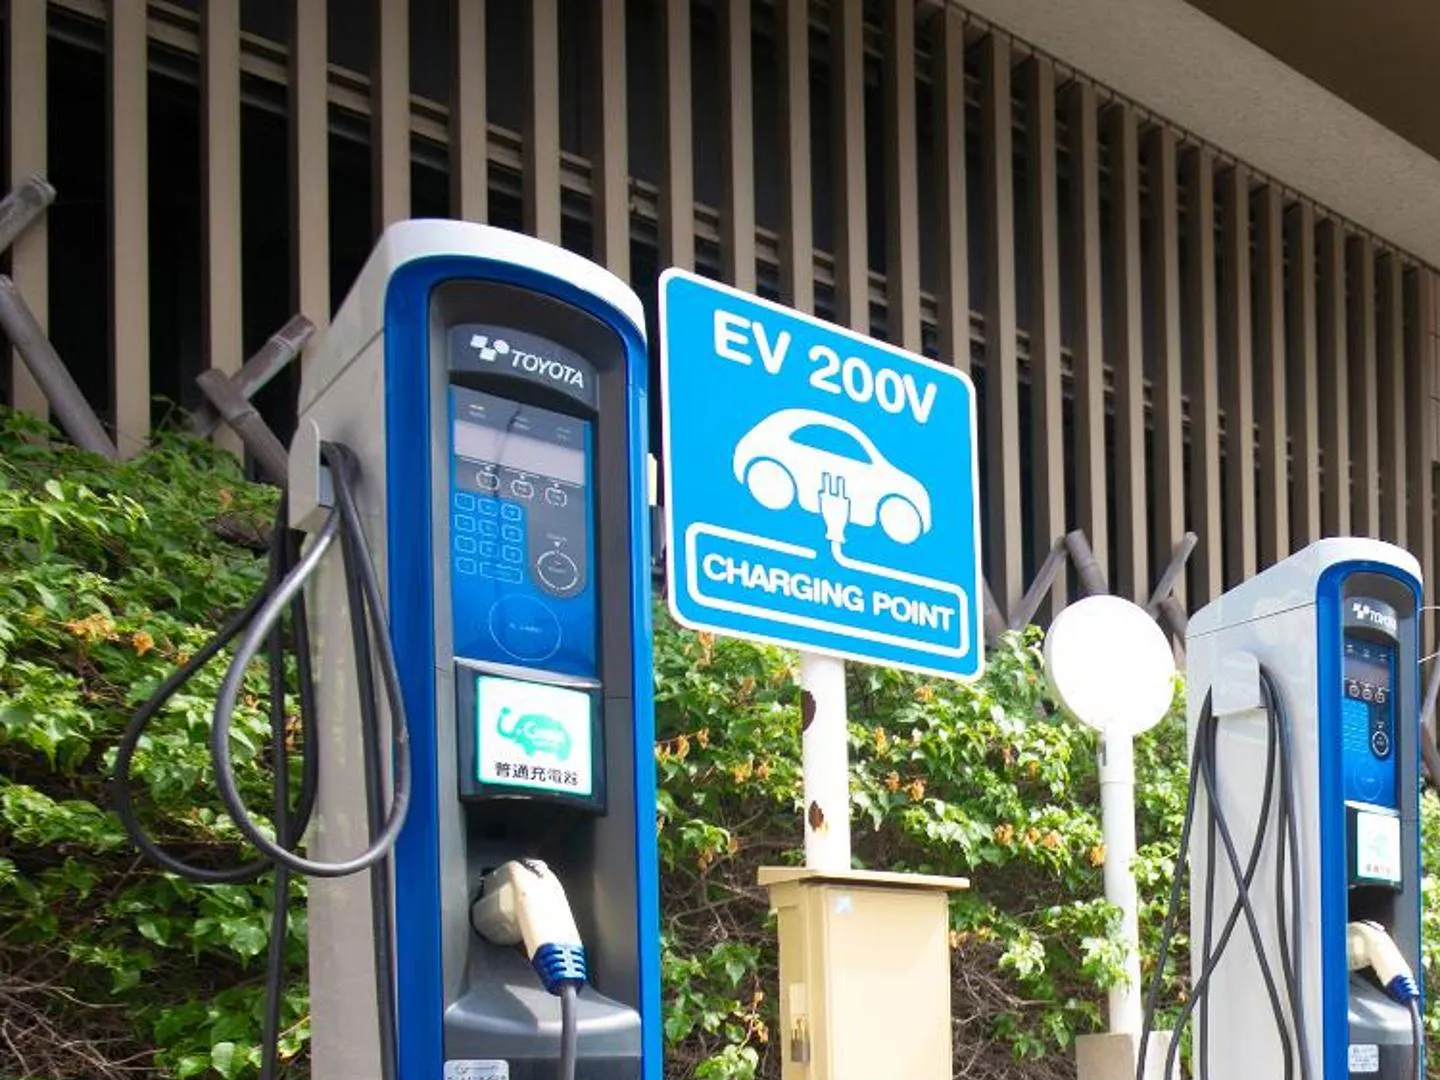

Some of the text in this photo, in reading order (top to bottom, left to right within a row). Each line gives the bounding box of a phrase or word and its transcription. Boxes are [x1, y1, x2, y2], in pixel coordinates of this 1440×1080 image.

[511, 350, 585, 389] TOYOTA
[714, 309, 937, 424] EV 200V
[702, 553, 955, 632] CHARGING POINT
